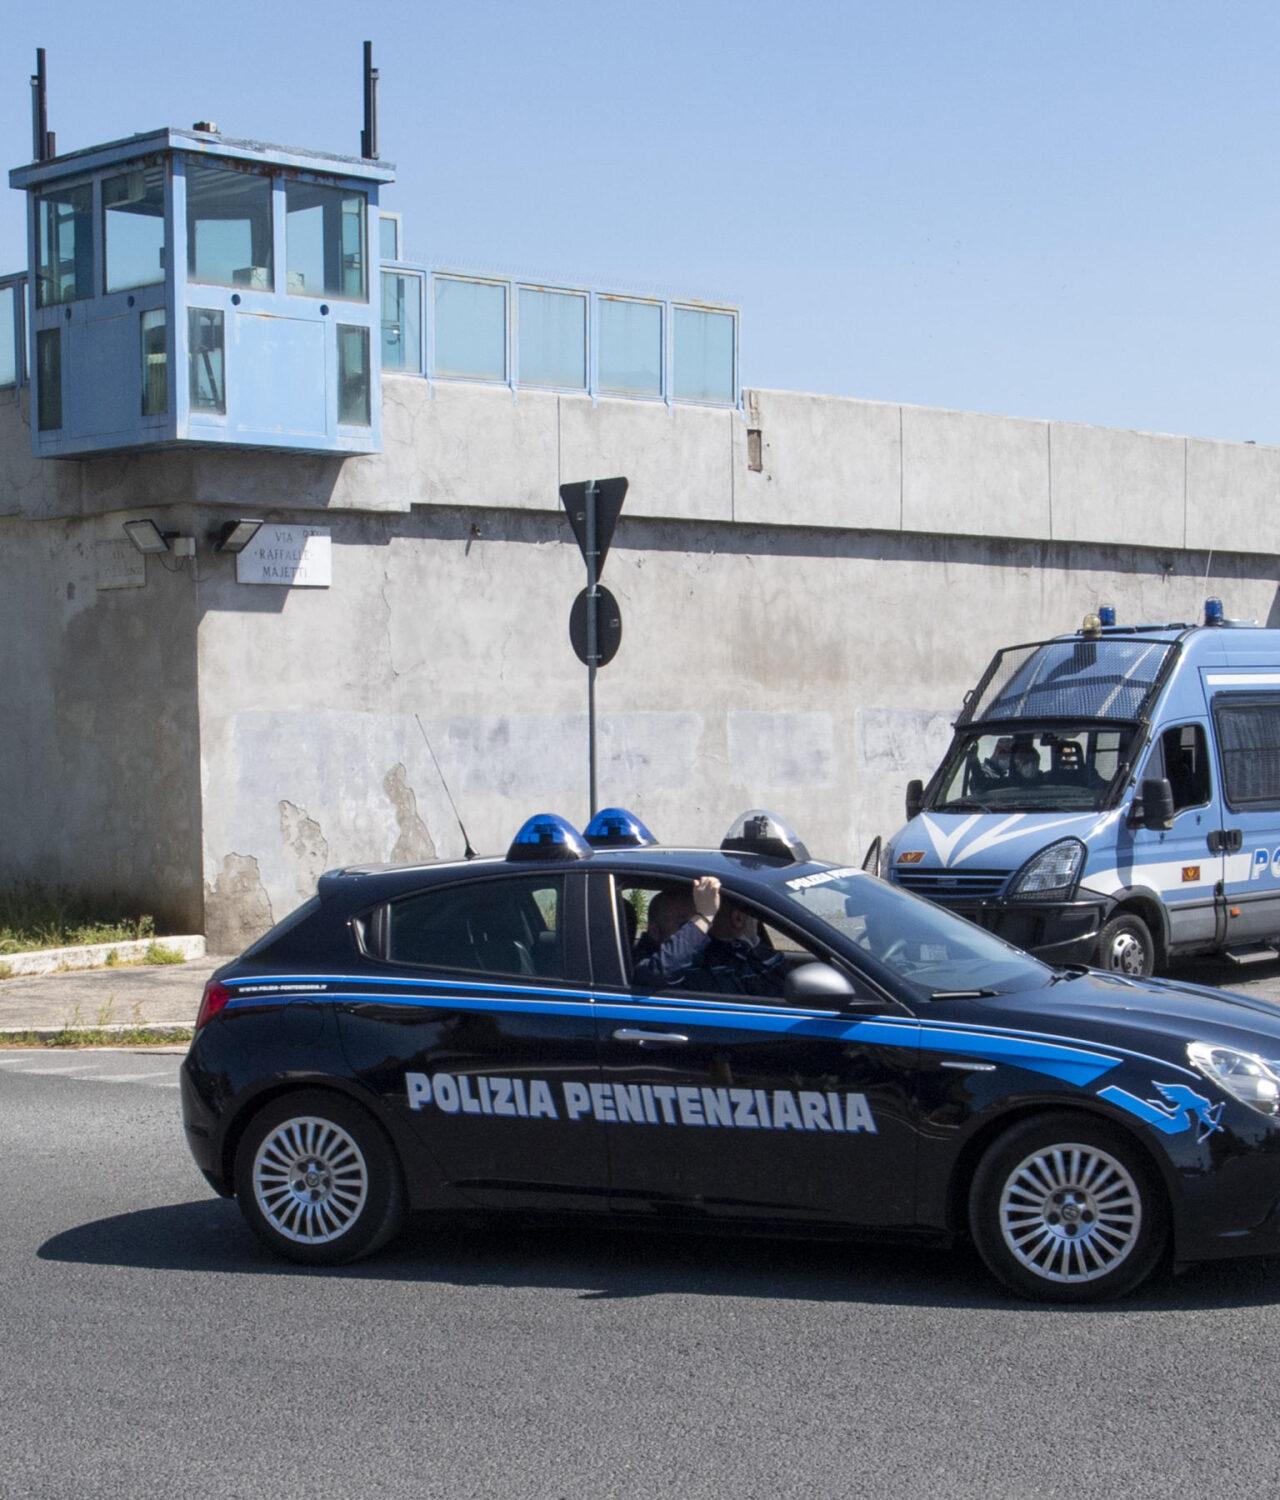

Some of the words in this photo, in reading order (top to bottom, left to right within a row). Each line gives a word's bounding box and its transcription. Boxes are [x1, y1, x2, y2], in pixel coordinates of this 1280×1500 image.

[275, 531, 293, 542] VIA
[262, 566, 308, 577] MAJETTI
[405, 1072, 560, 1120] POLIZIA
[562, 1082, 878, 1134] PENITENZIARIA
